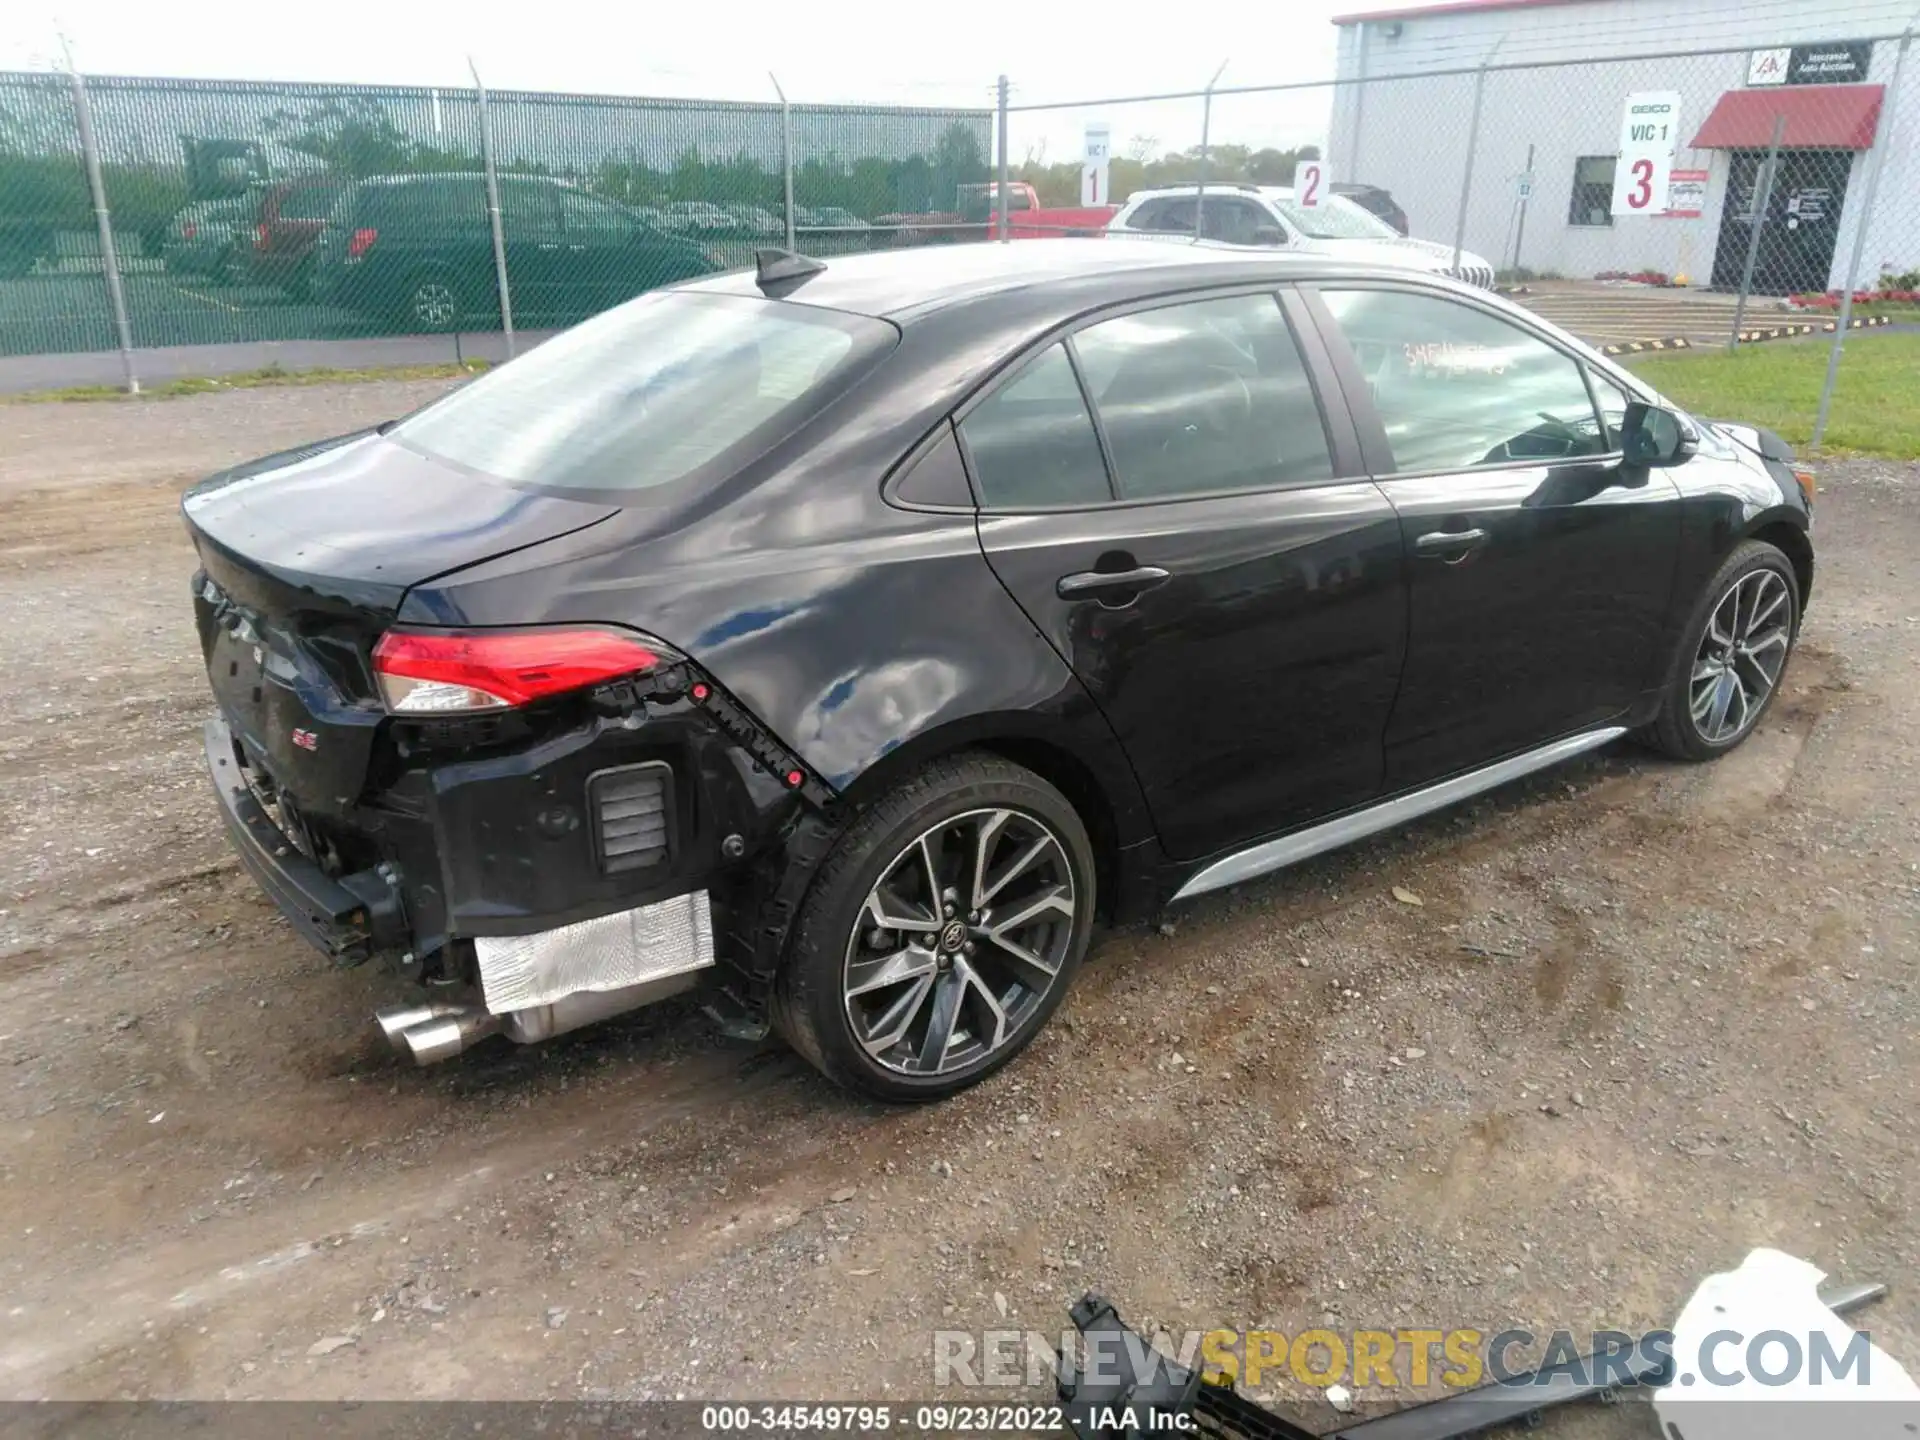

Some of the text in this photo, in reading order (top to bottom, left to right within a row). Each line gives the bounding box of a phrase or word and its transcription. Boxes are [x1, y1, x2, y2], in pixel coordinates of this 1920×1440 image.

[1631, 104, 1671, 114] GEICO
[1631, 124, 1668, 141] VIC 1
[1089, 167, 1097, 203] 1
[1302, 165, 1321, 207] 2
[1628, 159, 1654, 209] 3
